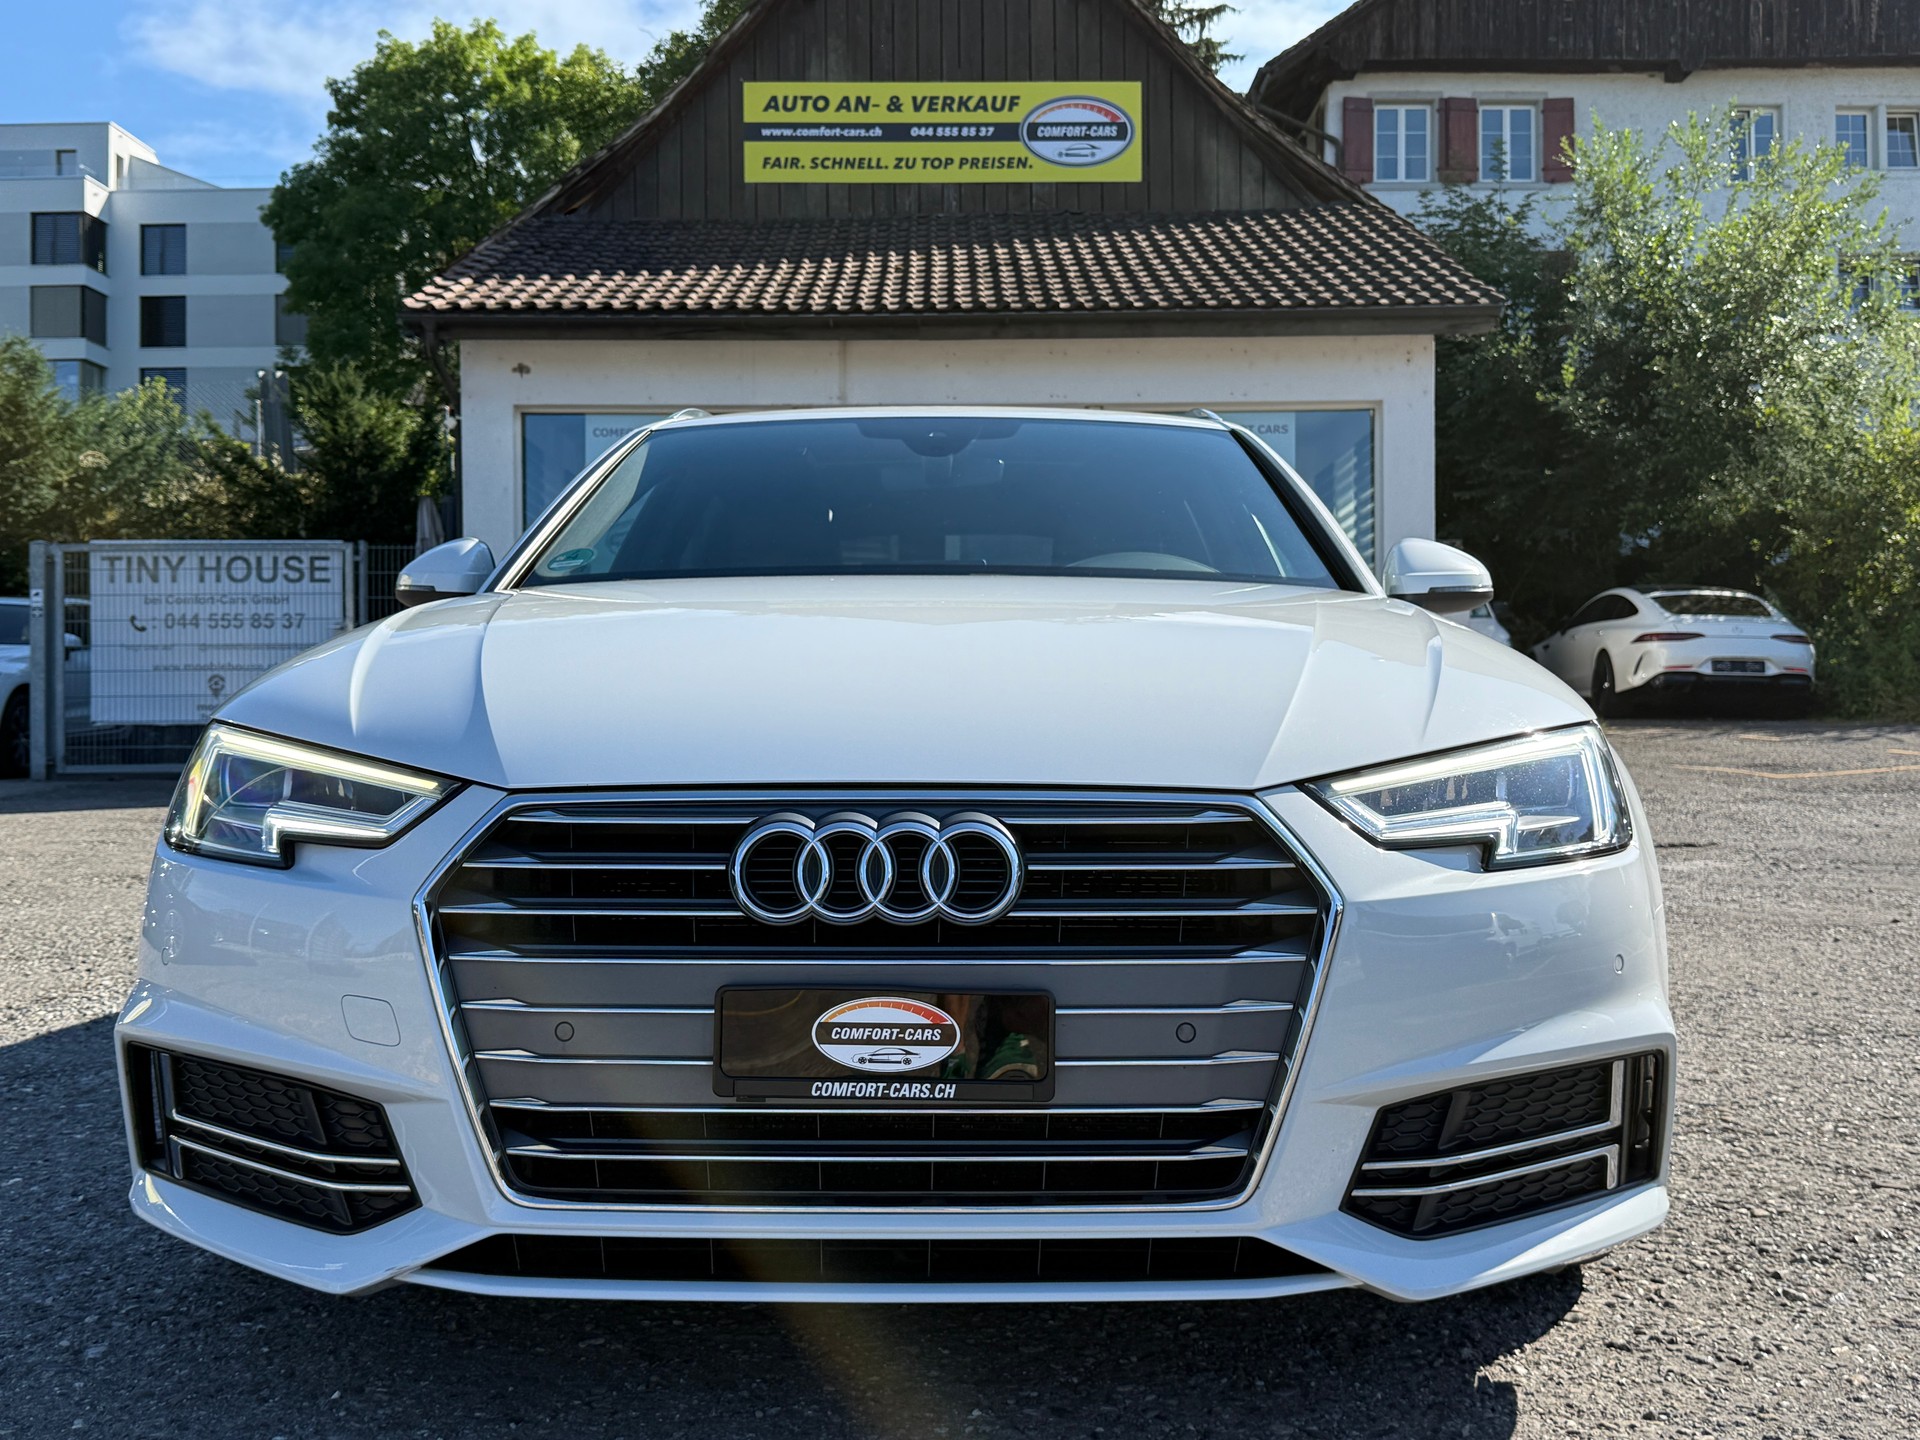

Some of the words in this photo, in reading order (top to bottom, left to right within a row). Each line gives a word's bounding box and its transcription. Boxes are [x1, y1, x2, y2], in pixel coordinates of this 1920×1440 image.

[763, 96, 830, 113] AUTO
[835, 96, 880, 113] AN-
[887, 96, 904, 113] &
[911, 95, 1020, 113] VERKAUF
[761, 126, 883, 138] www.comfort-cars.ch
[910, 126, 934, 137] 044
[936, 126, 957, 137] 555
[959, 126, 977, 137] 85
[978, 126, 995, 137] 37
[1037, 125, 1118, 138] COMFORT-CARS
[762, 156, 806, 170] FAIR.
[809, 156, 889, 170] SCHNELL.
[893, 156, 916, 170] ZU
[920, 156, 955, 170] TOP
[958, 156, 1034, 170] PREISEN.
[593, 427, 631, 438] COMF
[1257, 424, 1289, 435] CARS
[101, 555, 186, 584] TINY
[199, 555, 331, 584] HOUSE
[251, 594, 290, 606] GmbH
[164, 612, 200, 630] 044
[207, 612, 245, 630] 555
[250, 612, 276, 630] 85
[281, 612, 306, 630] 37
[831, 1027, 942, 1042] COMFORT-CARS
[810, 1081, 957, 1099] COMFORT-CARS.CH
